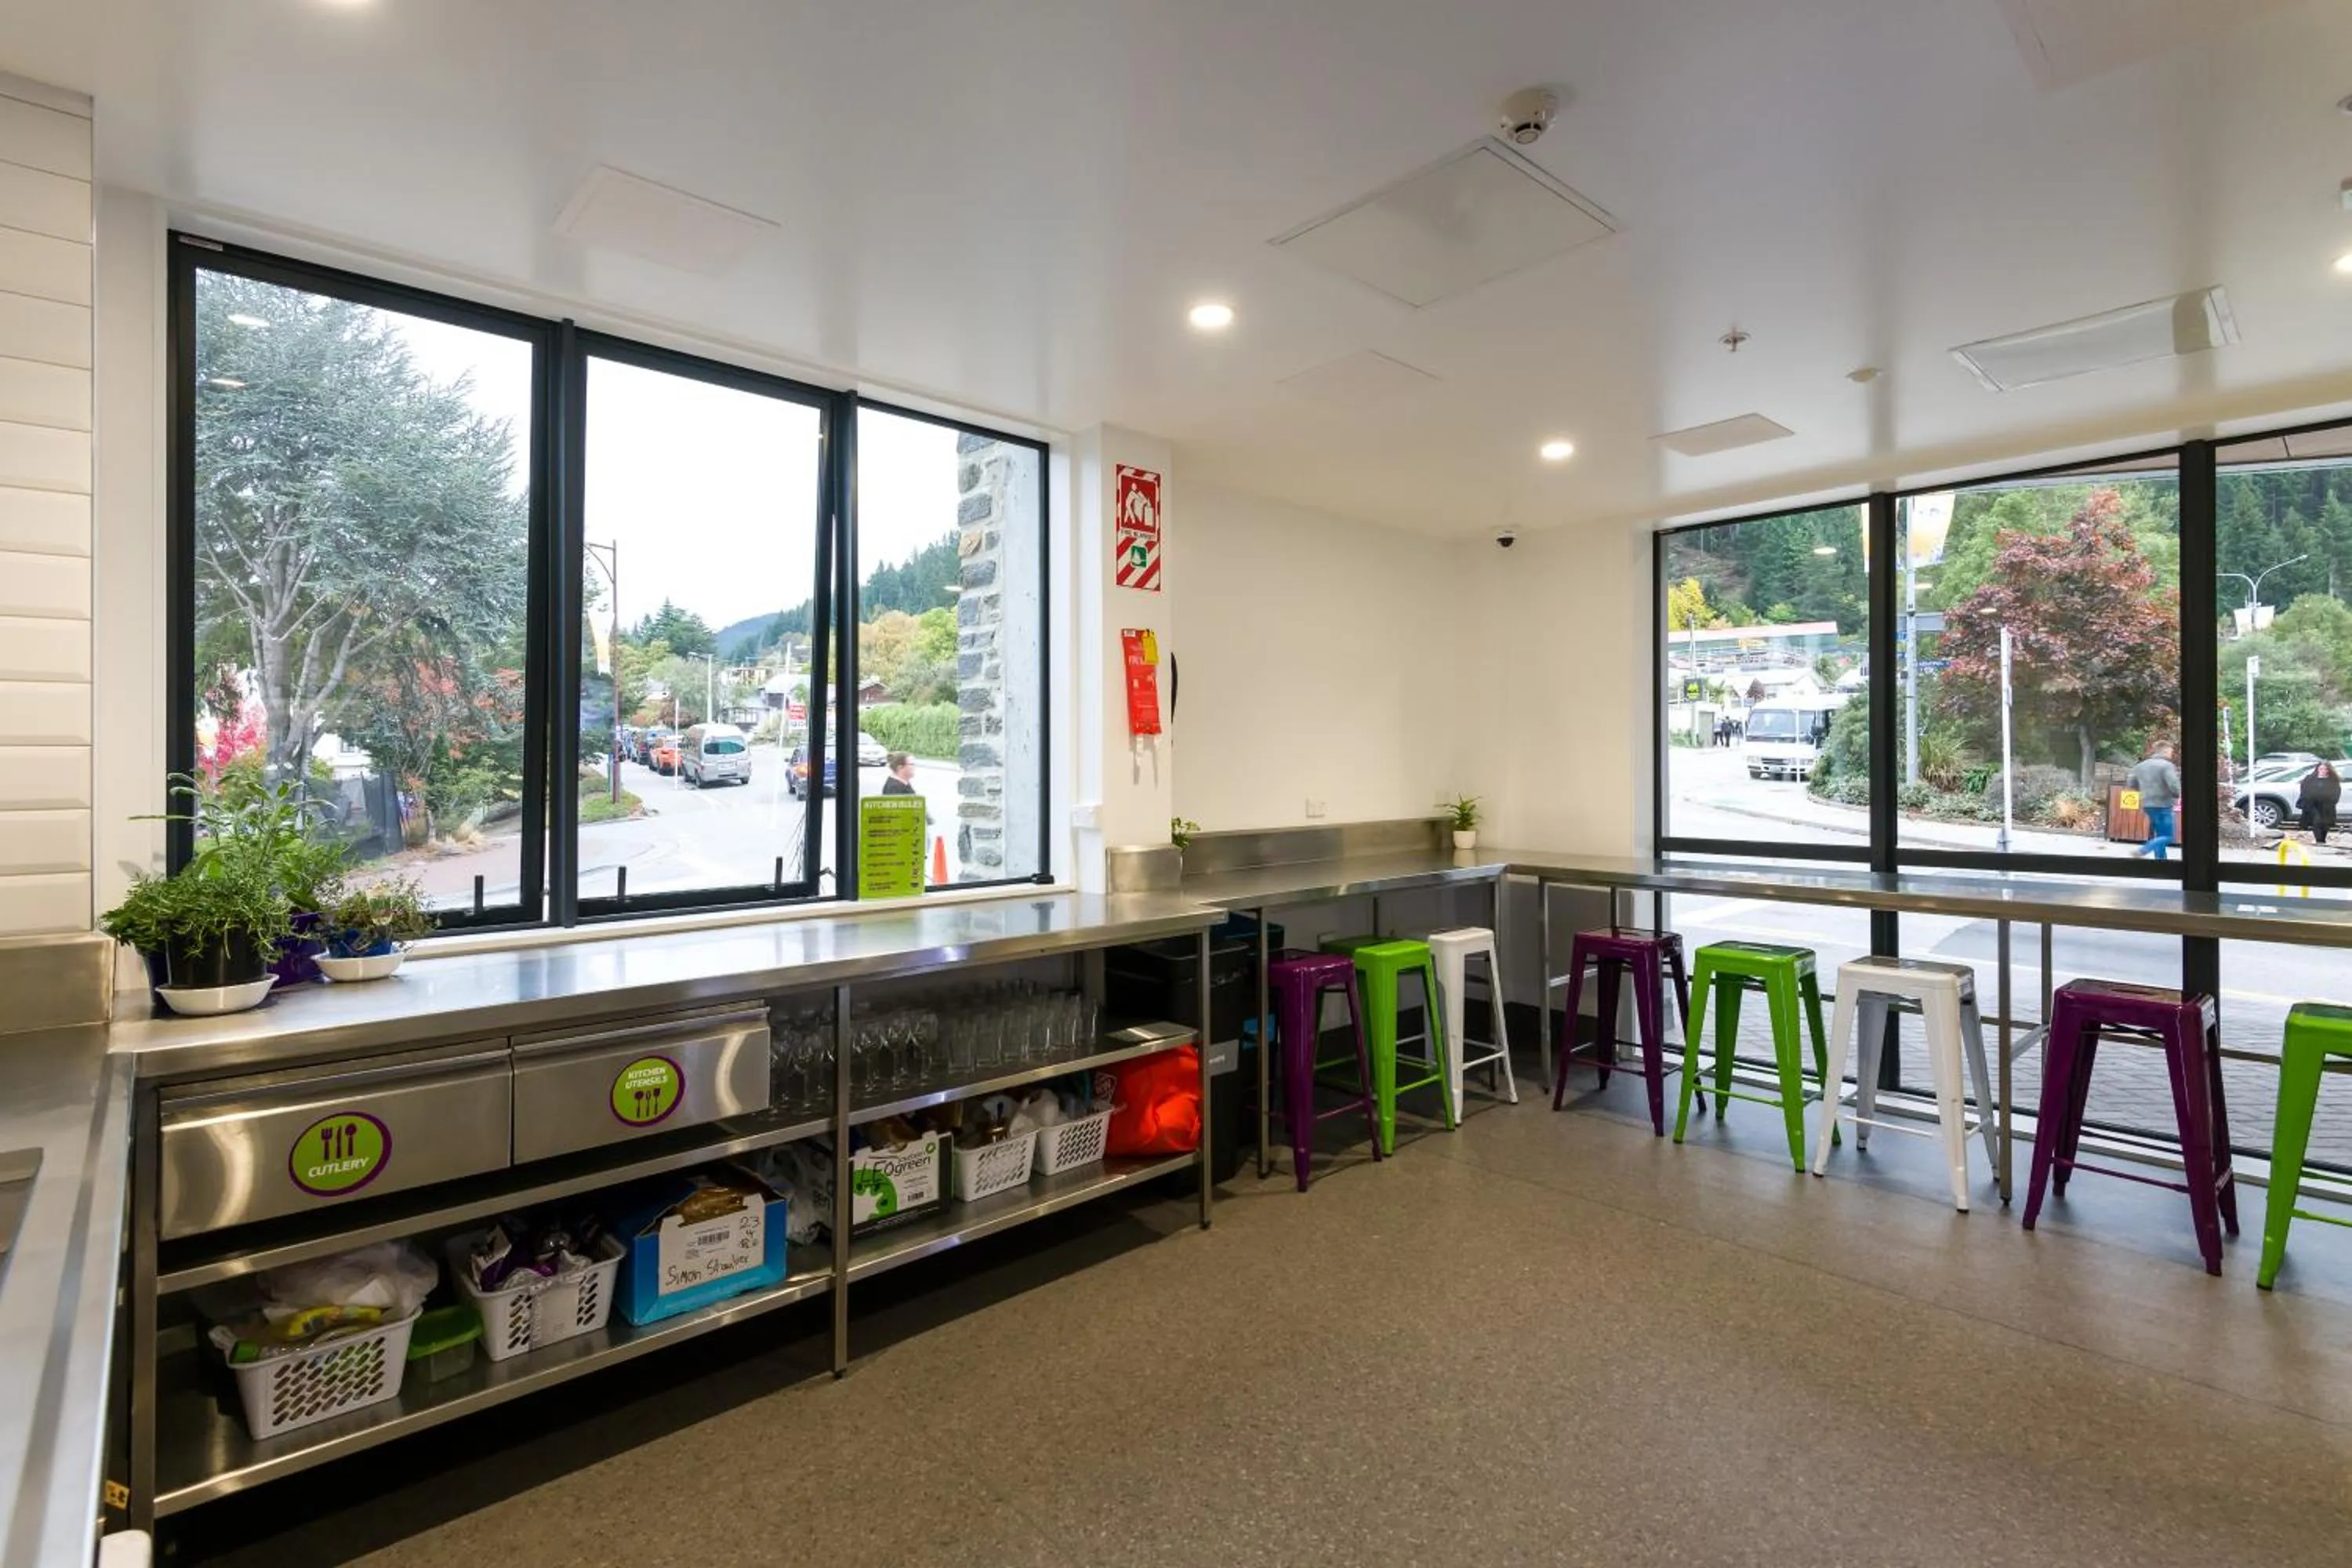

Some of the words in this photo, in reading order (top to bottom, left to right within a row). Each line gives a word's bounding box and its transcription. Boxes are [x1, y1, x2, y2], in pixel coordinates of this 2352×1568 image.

[628, 1067, 666, 1080] KITCHEN
[625, 1075, 669, 1090] UTENSILS
[308, 1157, 369, 1178] CUTLERY
